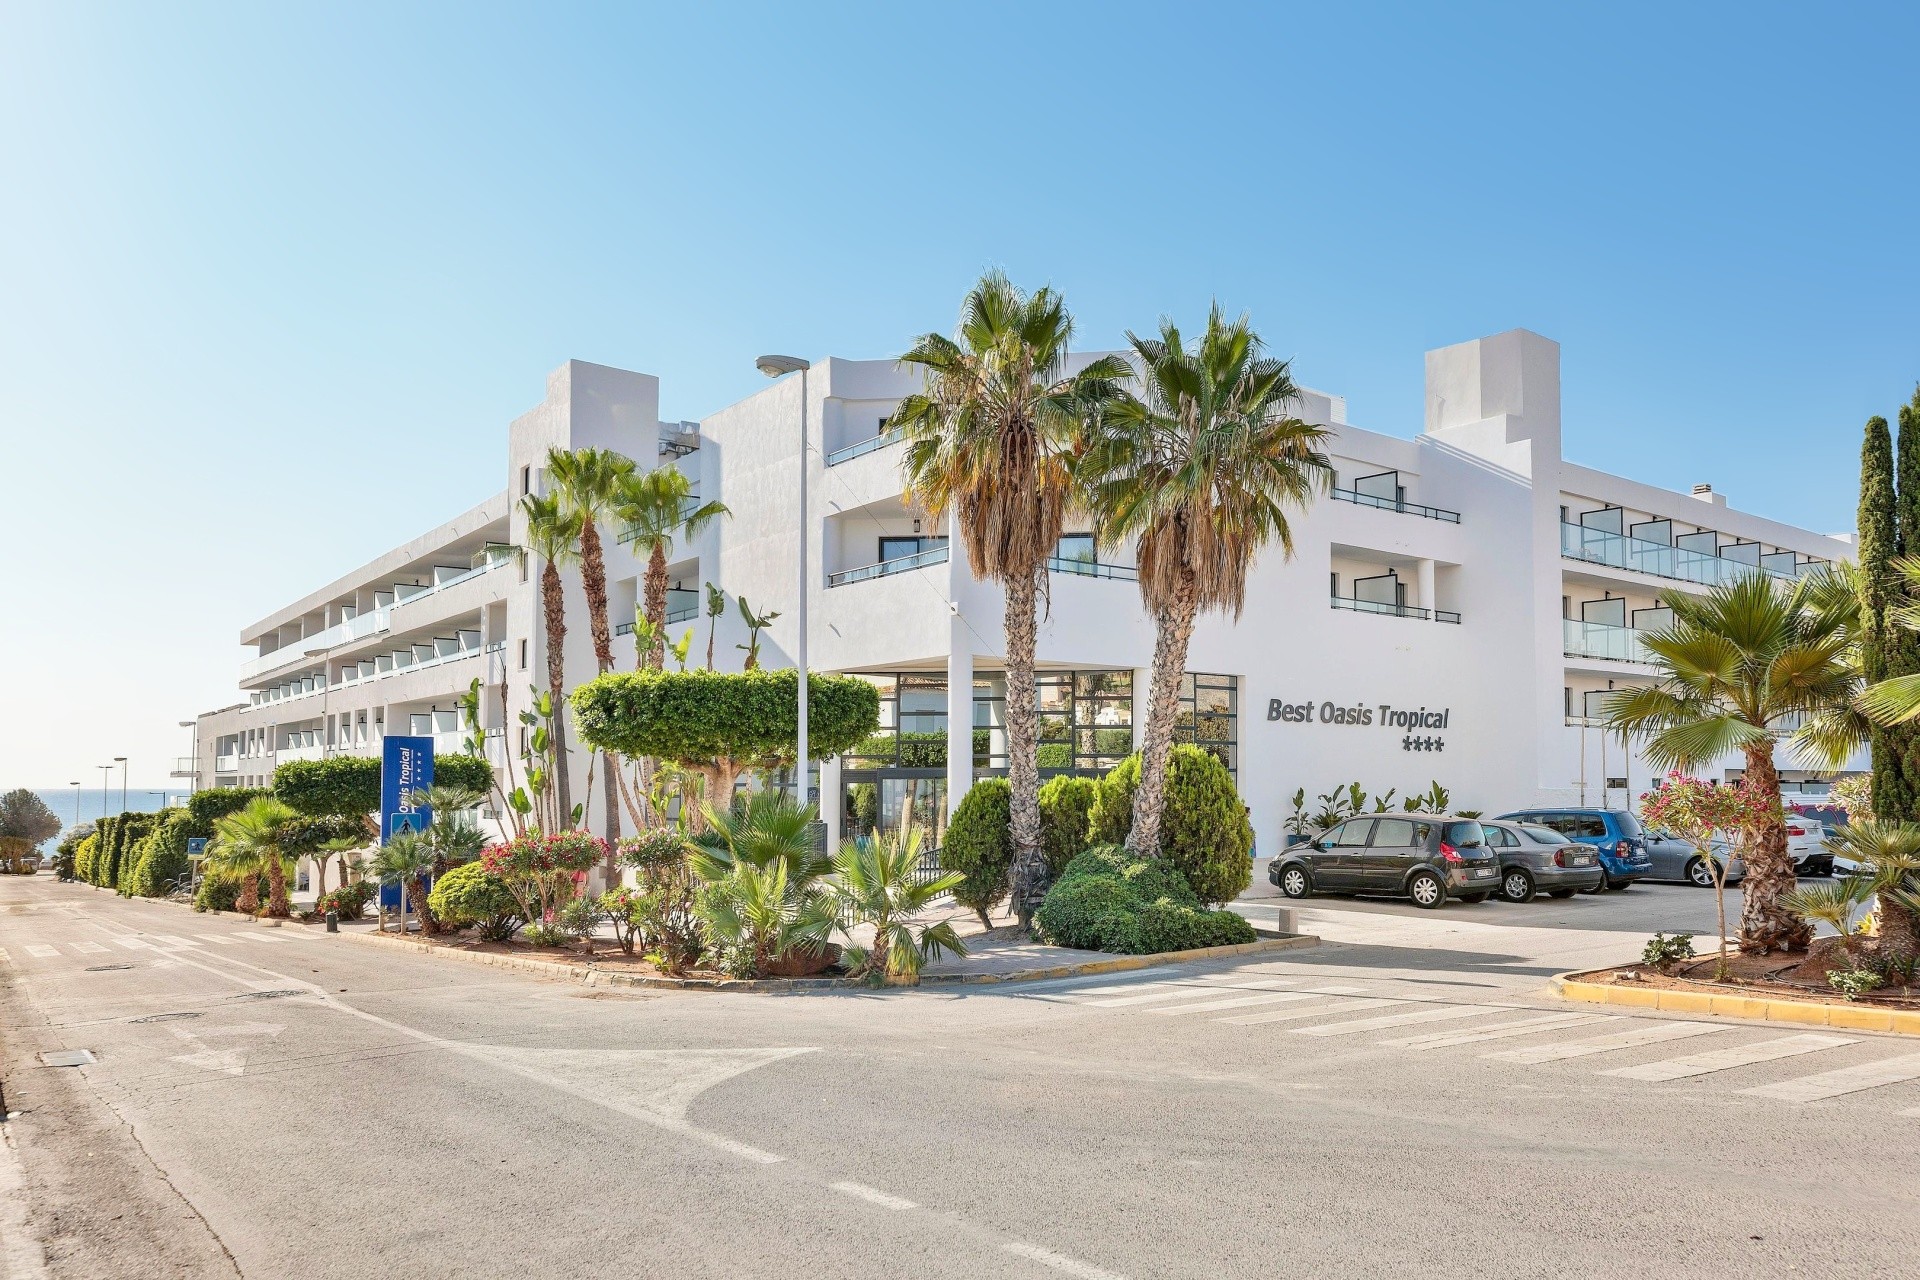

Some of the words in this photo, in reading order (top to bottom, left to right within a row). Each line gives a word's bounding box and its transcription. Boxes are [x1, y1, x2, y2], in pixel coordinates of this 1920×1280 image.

[1267, 698, 1315, 723] Best
[1320, 701, 1373, 726] Oasis
[1379, 704, 1450, 733] Tropical
[399, 747, 412, 785] Tropical
[399, 787, 410, 813] Oasis
